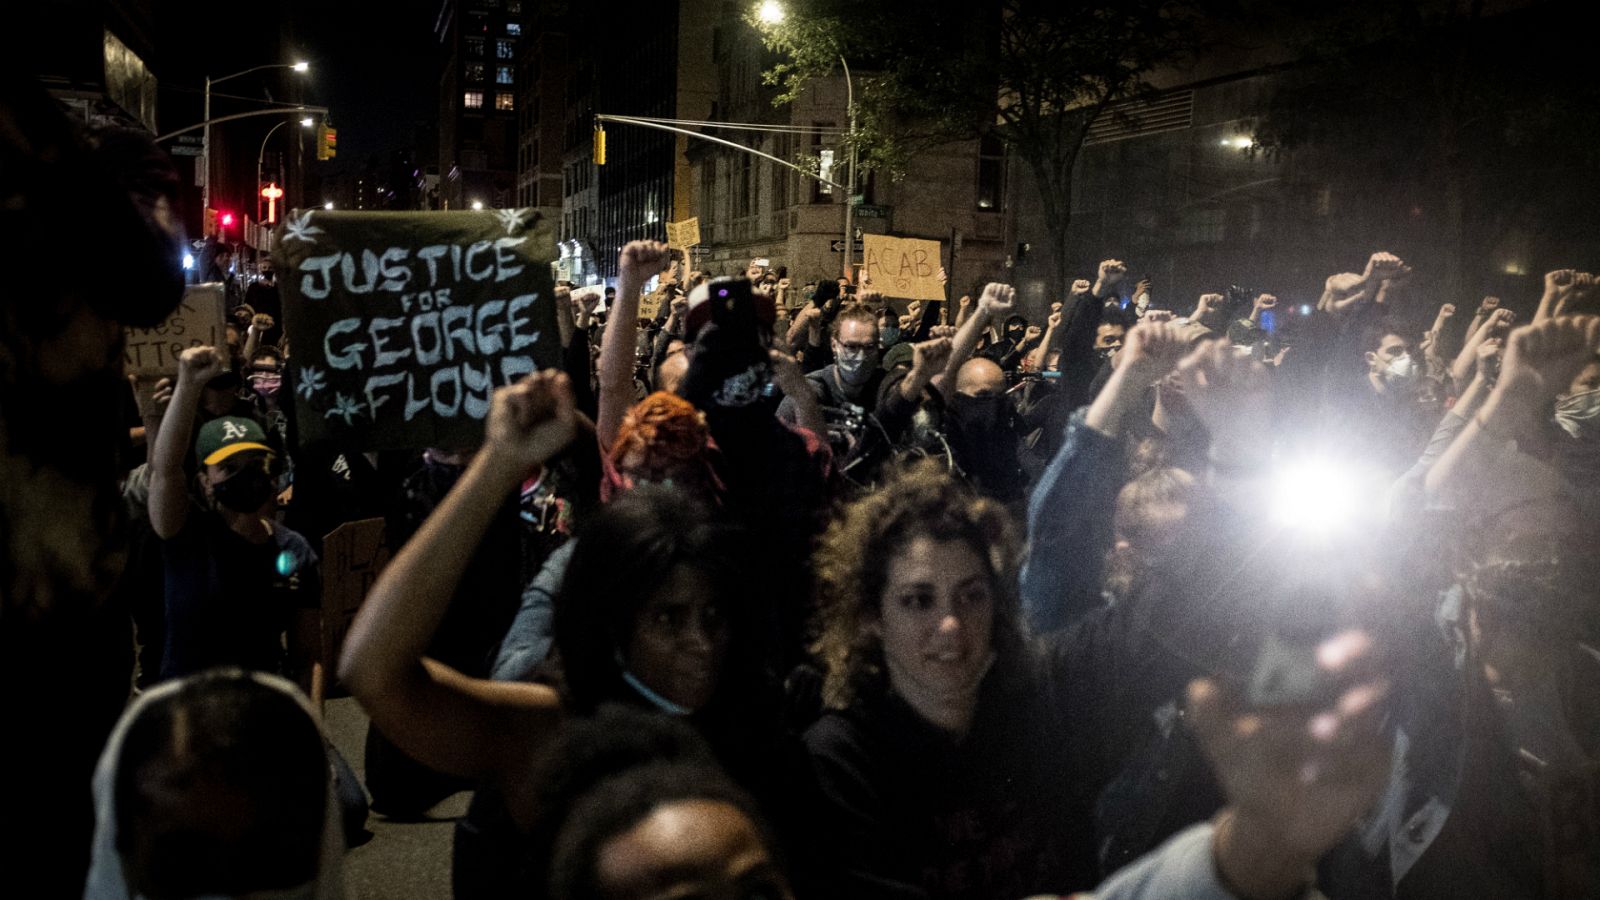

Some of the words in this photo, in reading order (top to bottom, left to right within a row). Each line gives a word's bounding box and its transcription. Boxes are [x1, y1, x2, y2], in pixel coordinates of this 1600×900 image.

[299, 237, 528, 300] JUSTICE
[867, 247, 932, 278] ACAB
[401, 288, 452, 313] FOR
[324, 293, 541, 371] GEORGE
